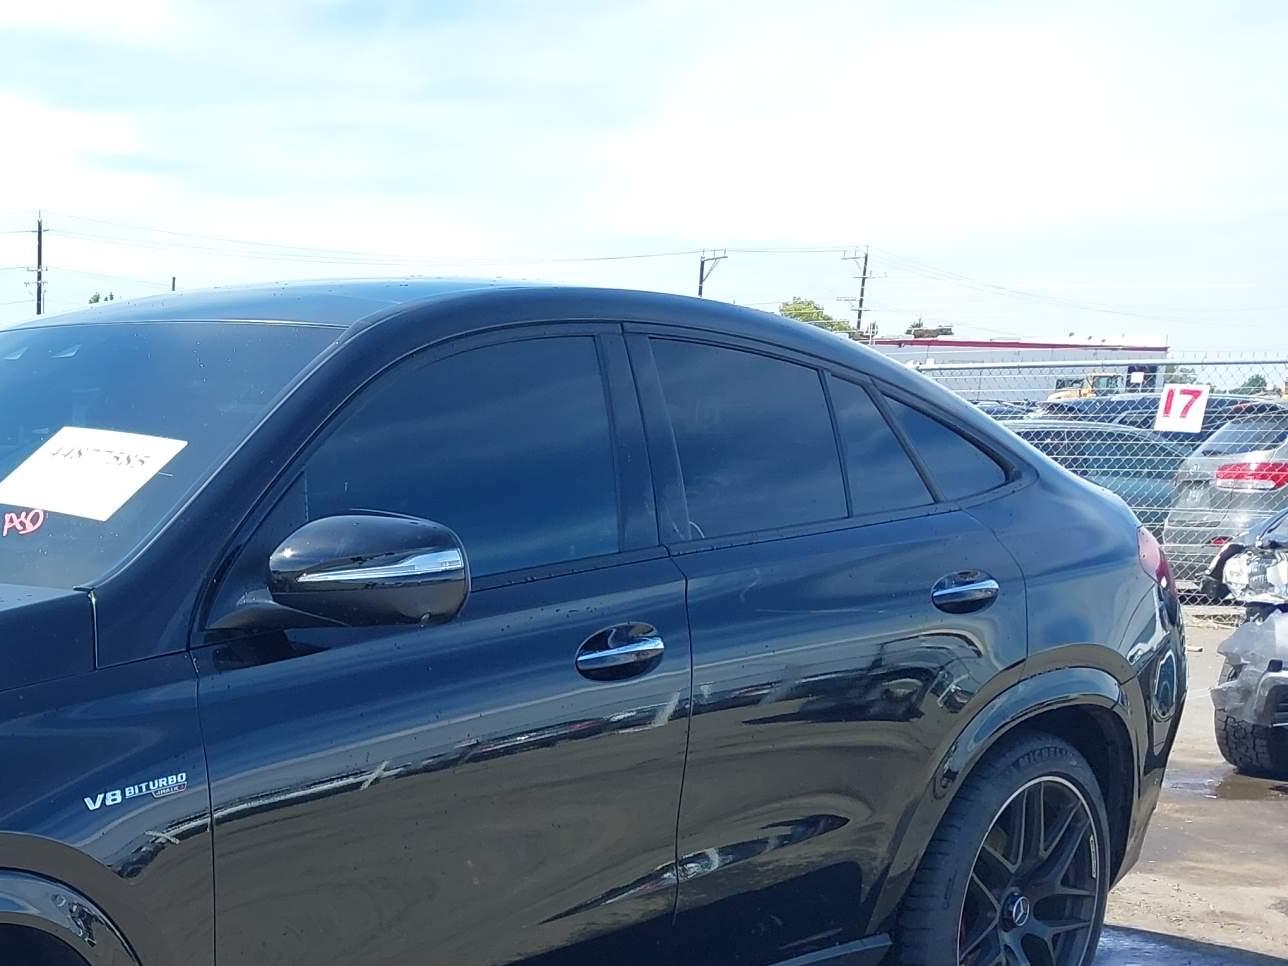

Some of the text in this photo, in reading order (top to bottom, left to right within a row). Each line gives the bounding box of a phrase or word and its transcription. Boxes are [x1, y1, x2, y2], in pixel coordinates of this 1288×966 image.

[1163, 389, 1203, 418] 17
[84, 772, 187, 811] V8 BITURBO
